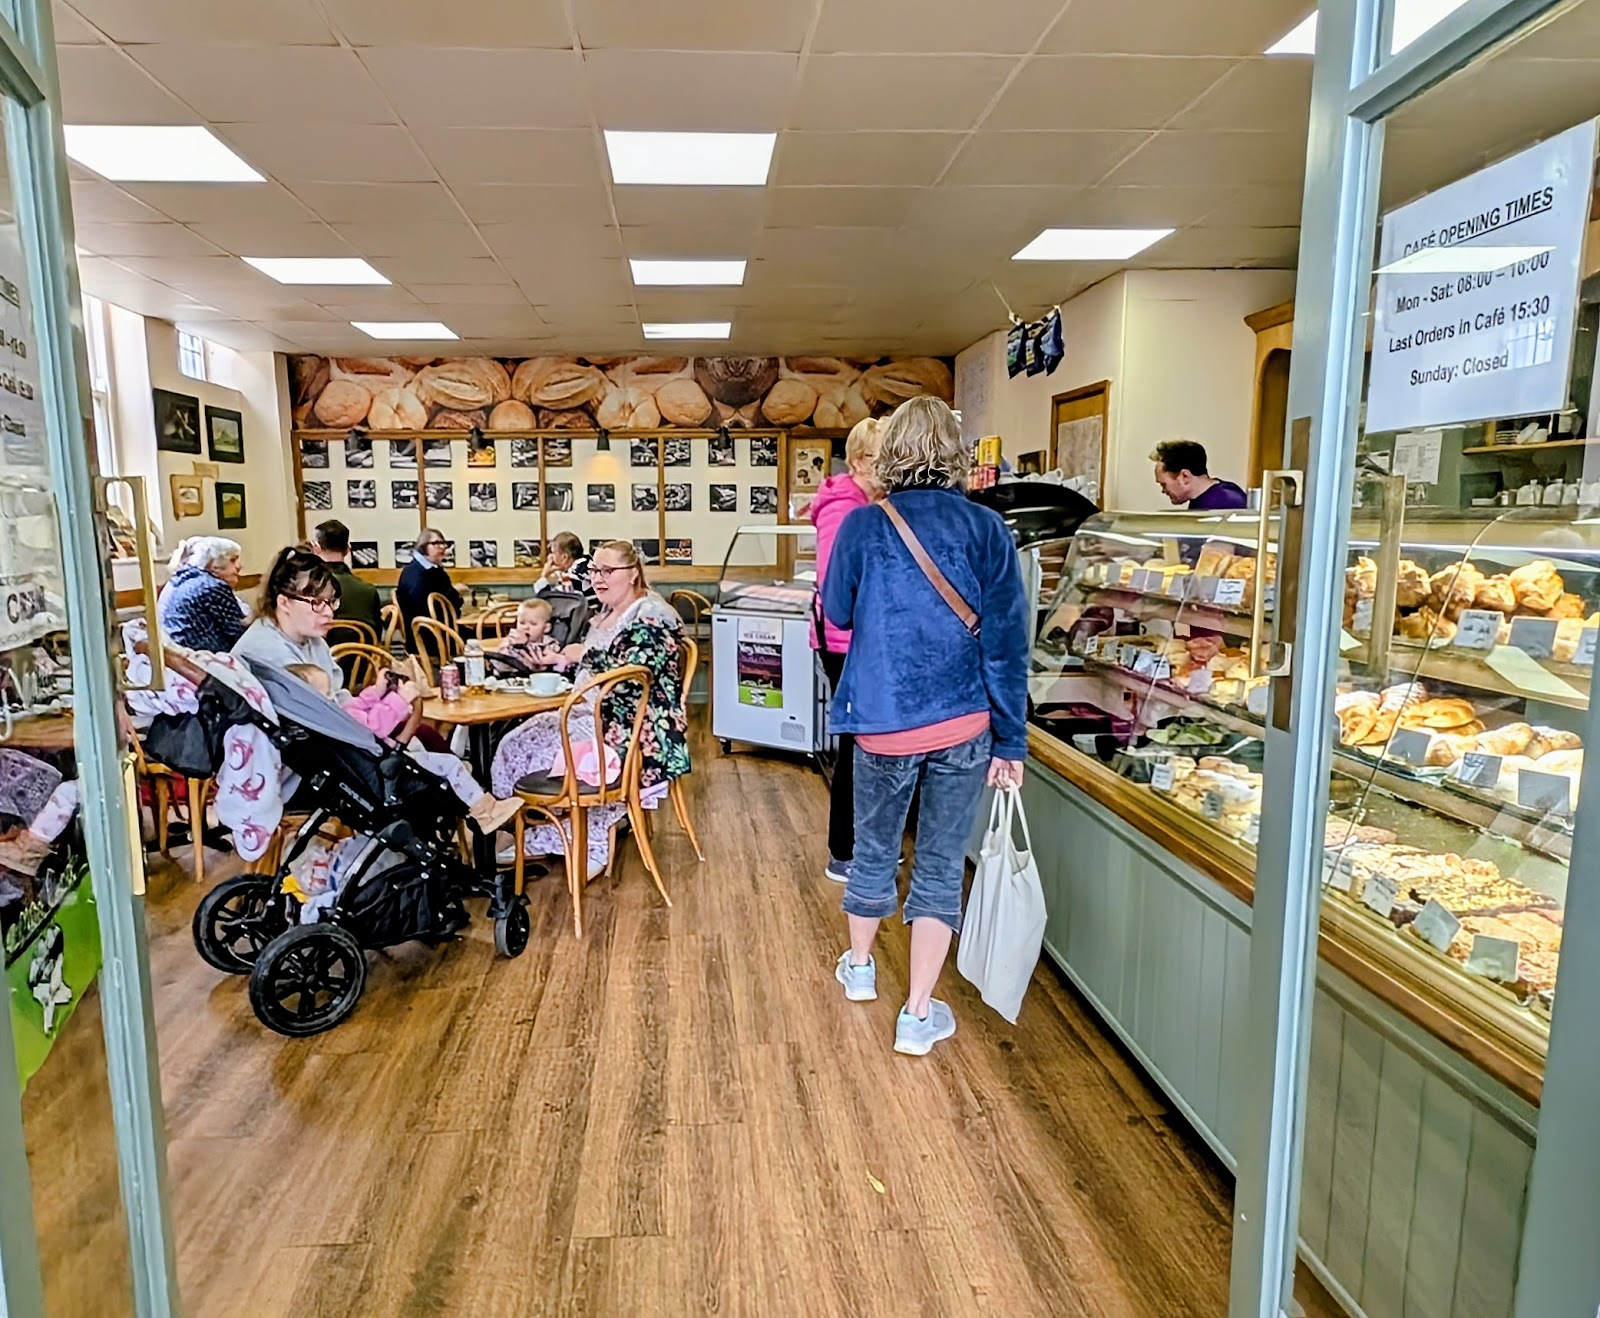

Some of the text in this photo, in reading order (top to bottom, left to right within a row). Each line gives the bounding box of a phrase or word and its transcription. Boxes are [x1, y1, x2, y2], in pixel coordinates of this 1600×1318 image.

[1403, 186, 1553, 258] CAFÉ OPENING TIMES
[1396, 295, 1420, 313] Mon
[1430, 283, 1453, 302] Sat:
[1457, 271, 1492, 294] 08:00
[1511, 250, 1550, 278] 16:00
[1389, 295, 1550, 353] Last Orders in Café 15:30
[1410, 348, 1508, 386] Sunday: Closed
